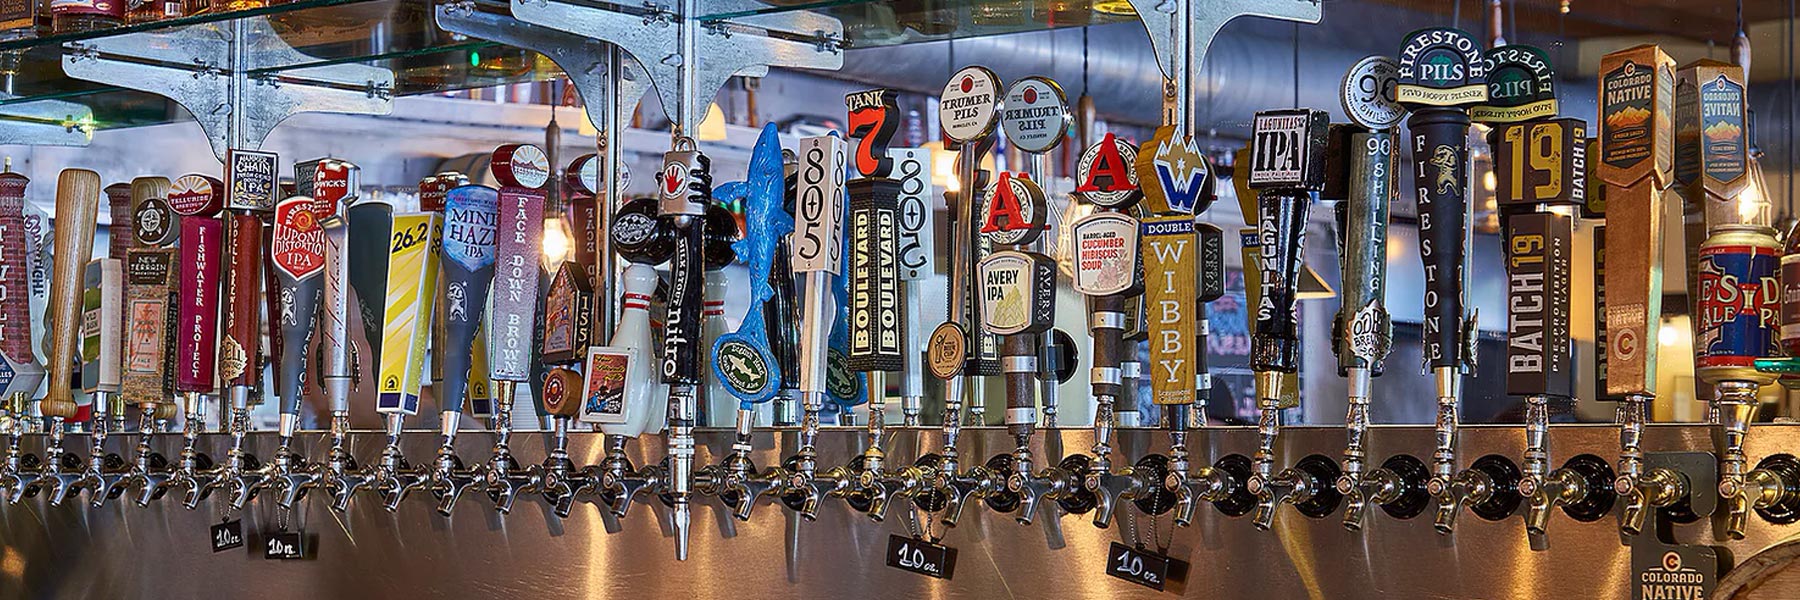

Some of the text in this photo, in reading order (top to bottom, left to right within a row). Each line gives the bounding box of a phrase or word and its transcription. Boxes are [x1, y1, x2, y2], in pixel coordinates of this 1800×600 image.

[1398, 30, 1483, 79] FIRESTONE
[1420, 63, 1464, 81] PILS
[1607, 73, 1652, 90] COLORADO
[846, 89, 886, 112] TANK
[942, 93, 992, 111] TRUMER
[1607, 85, 1651, 106] NATIVE
[953, 106, 979, 121] PILS
[848, 107, 887, 176] 7
[1254, 130, 1301, 171] IPA
[1366, 137, 1391, 157] 90
[236, 160, 271, 174] CHAIN
[1505, 122, 1563, 201] 19
[243, 181, 264, 193] IPA
[285, 202, 316, 226] FIREST
[798, 147, 825, 260] 805
[829, 150, 845, 262] 805
[391, 222, 429, 255] 26.2
[1148, 220, 1193, 235] DOUBLE
[1369, 162, 1385, 293] SHILLING
[275, 239, 325, 257] DISTORTIO
[464, 245, 484, 258] IPA
[1081, 249, 1118, 261] HIBISCUS
[1082, 237, 1125, 250] CUCUMBER
[1415, 134, 1442, 360] FIRESTONE
[130, 263, 167, 271] TERRAIN
[287, 253, 312, 267] IPA
[1081, 260, 1103, 271] SOUR
[1258, 207, 1277, 321] LAGUNITAS
[503, 197, 529, 372] FACE DOWN BROWN
[672, 271, 685, 306] STOUT
[854, 213, 869, 349] BOULEVARD
[879, 213, 896, 348] BOULEVARD
[987, 269, 1020, 286] AVERY
[191, 226, 207, 378] FISHWATER PROJECT
[987, 286, 1005, 301] IPA
[1042, 265, 1051, 321] AVERY
[1509, 234, 1544, 373] BATCH 19
[1552, 236, 1561, 372] PRE-PROHIBITION
[1151, 239, 1188, 383] WIBBY
[1559, 258, 1568, 353] STYLE LAGER
[1701, 306, 1737, 328] ALE
[1608, 310, 1645, 328] NATIVE
[295, 289, 322, 411] FIRESTONE
[663, 307, 687, 377] nitro
[216, 528, 231, 548] 10
[268, 538, 283, 555] 10
[898, 542, 925, 569] 10
[1117, 550, 1144, 577] 10
[1641, 572, 1704, 584] COLORADO
[1641, 584, 1704, 600] NATIVE
